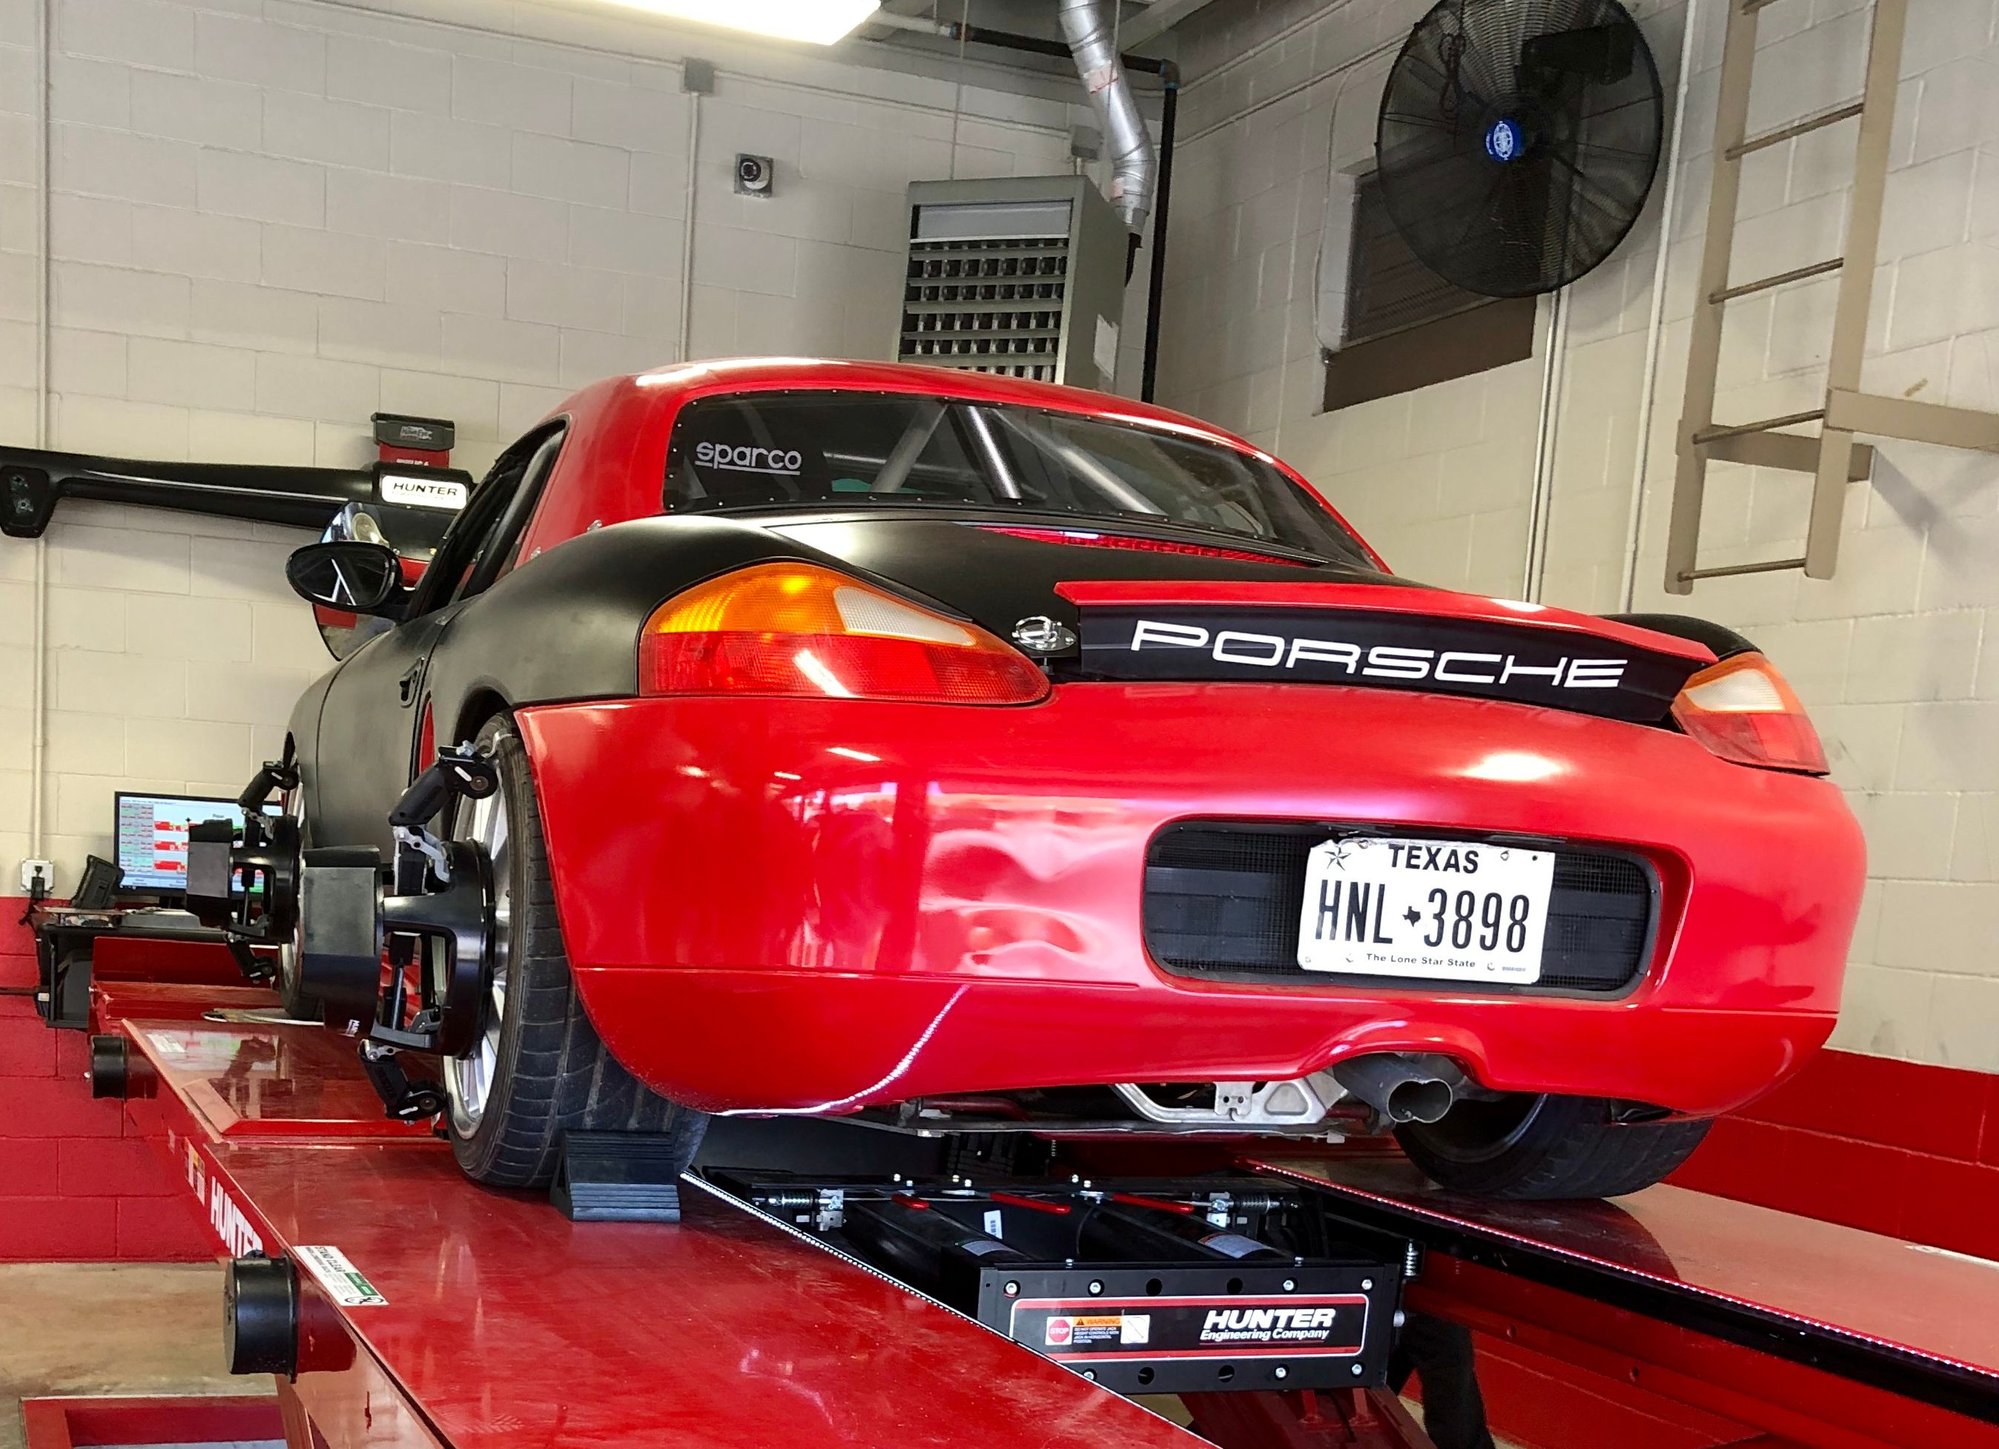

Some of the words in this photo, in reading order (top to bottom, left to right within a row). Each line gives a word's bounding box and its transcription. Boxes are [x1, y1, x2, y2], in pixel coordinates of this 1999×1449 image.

[696, 441, 802, 470] sparco
[393, 482, 458, 496] HUNTER
[1131, 619, 1628, 688] PORSCHE
[1388, 843, 1480, 875] TEXAS
[1315, 879, 1394, 945] HNL
[1423, 888, 1530, 953] 3898
[1366, 952, 1387, 963] The
[1390, 954, 1417, 965] Lone
[1421, 956, 1443, 967] Star
[1447, 958, 1476, 968] State
[1087, 1317, 1121, 1326] WARNING
[1203, 1308, 1336, 1330] HUNTER
[1049, 1327, 1071, 1336] STOP
[1200, 1328, 1271, 1342] Engineering
[1272, 1328, 1330, 1340] Company
